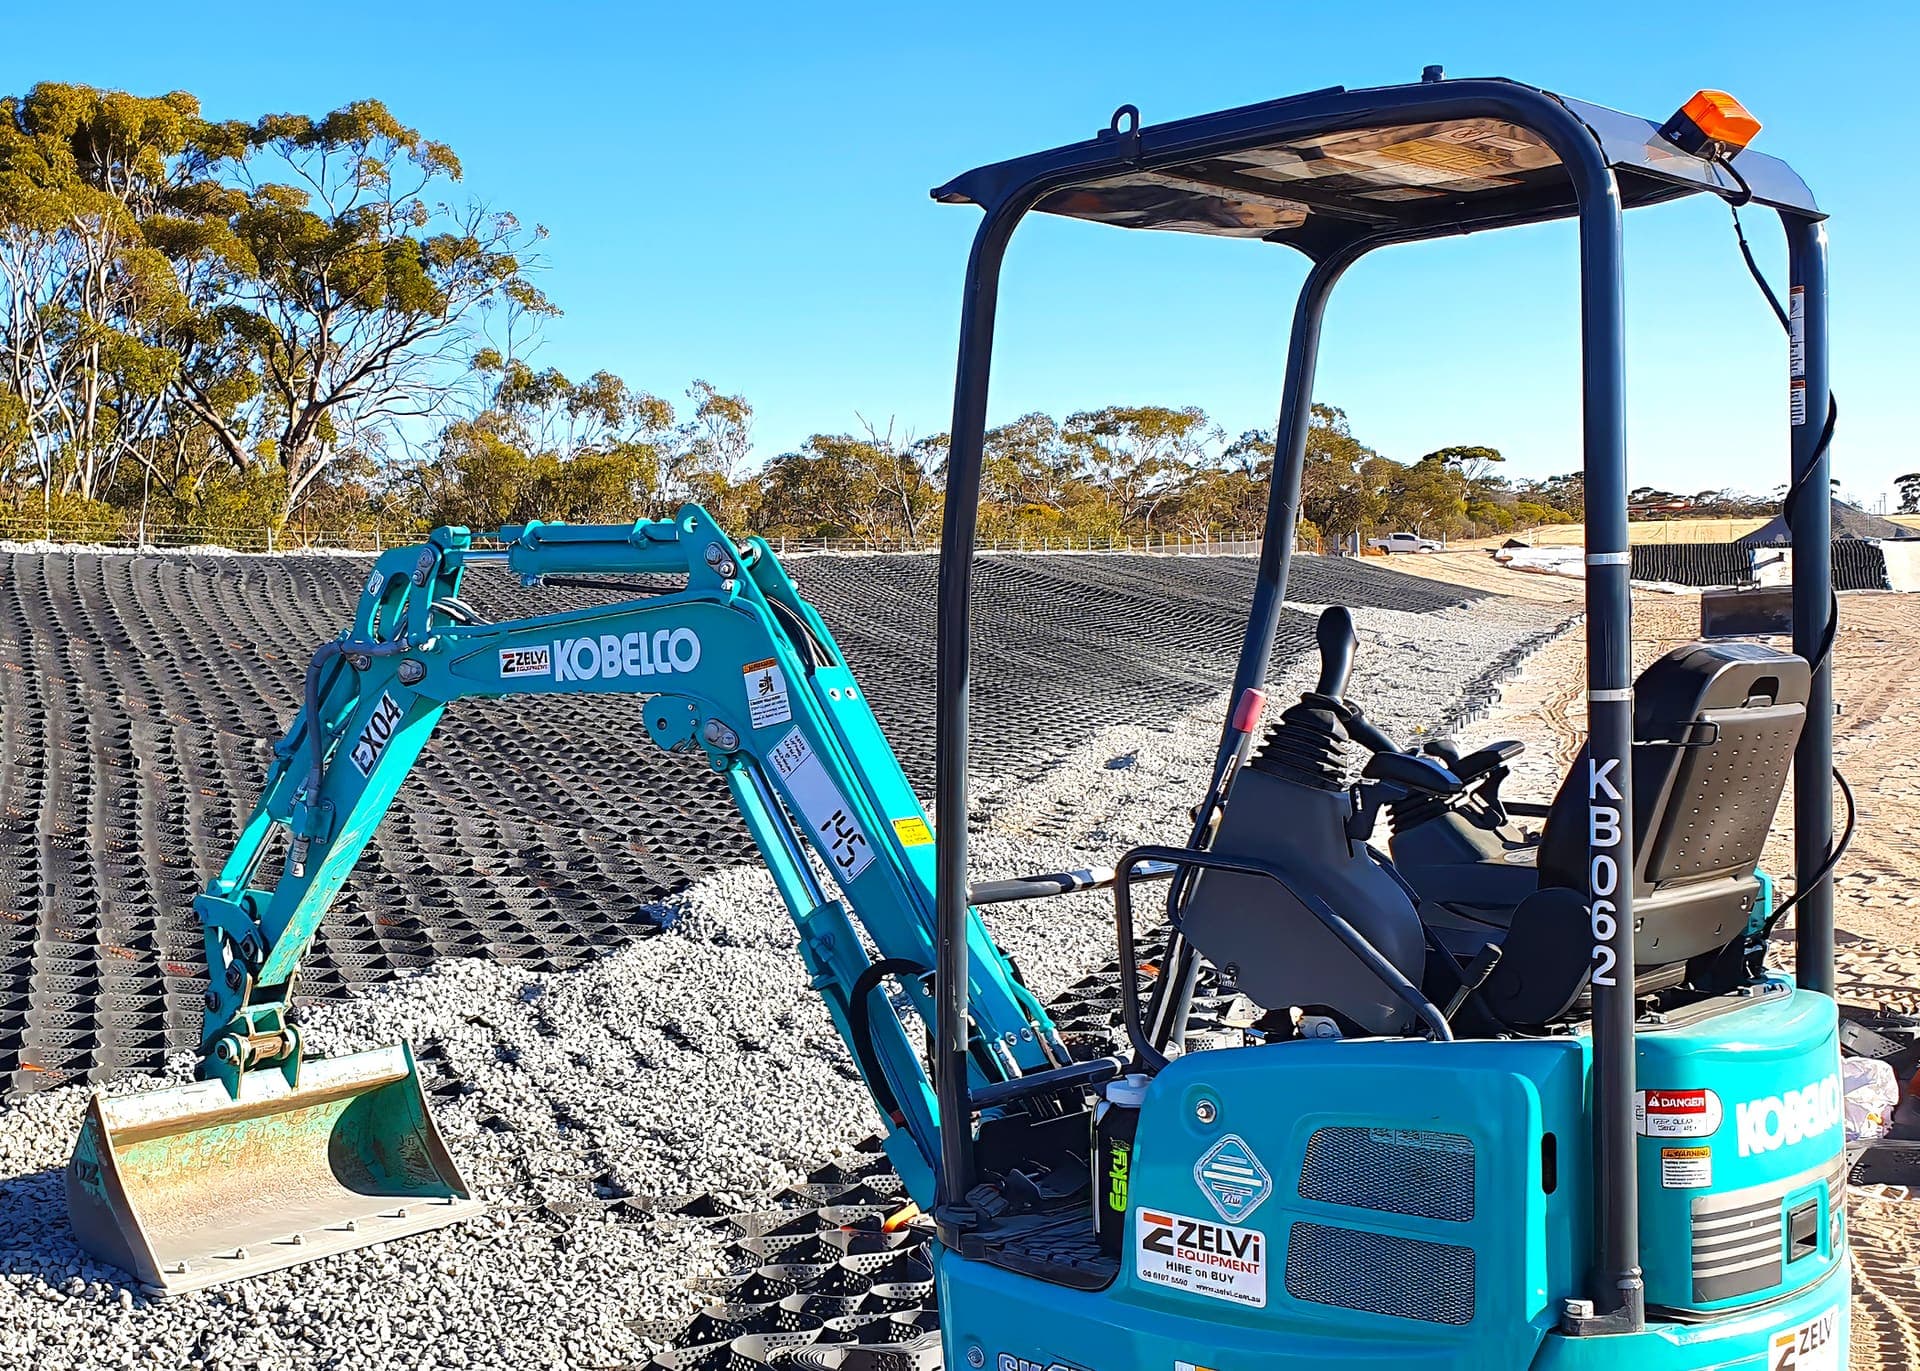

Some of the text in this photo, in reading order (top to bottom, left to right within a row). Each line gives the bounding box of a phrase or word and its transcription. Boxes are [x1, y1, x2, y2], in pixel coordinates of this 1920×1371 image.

[553, 627, 701, 682] KOBELCO
[350, 694, 401, 775] EX04
[1661, 1097, 1705, 1108] DANGER
[1736, 1073, 1839, 1158] KOBELCO
[1166, 1261, 1192, 1275] HIRE
[1211, 1271, 1235, 1284] BUY
[1177, 1248, 1260, 1275] EQUIPMENT
